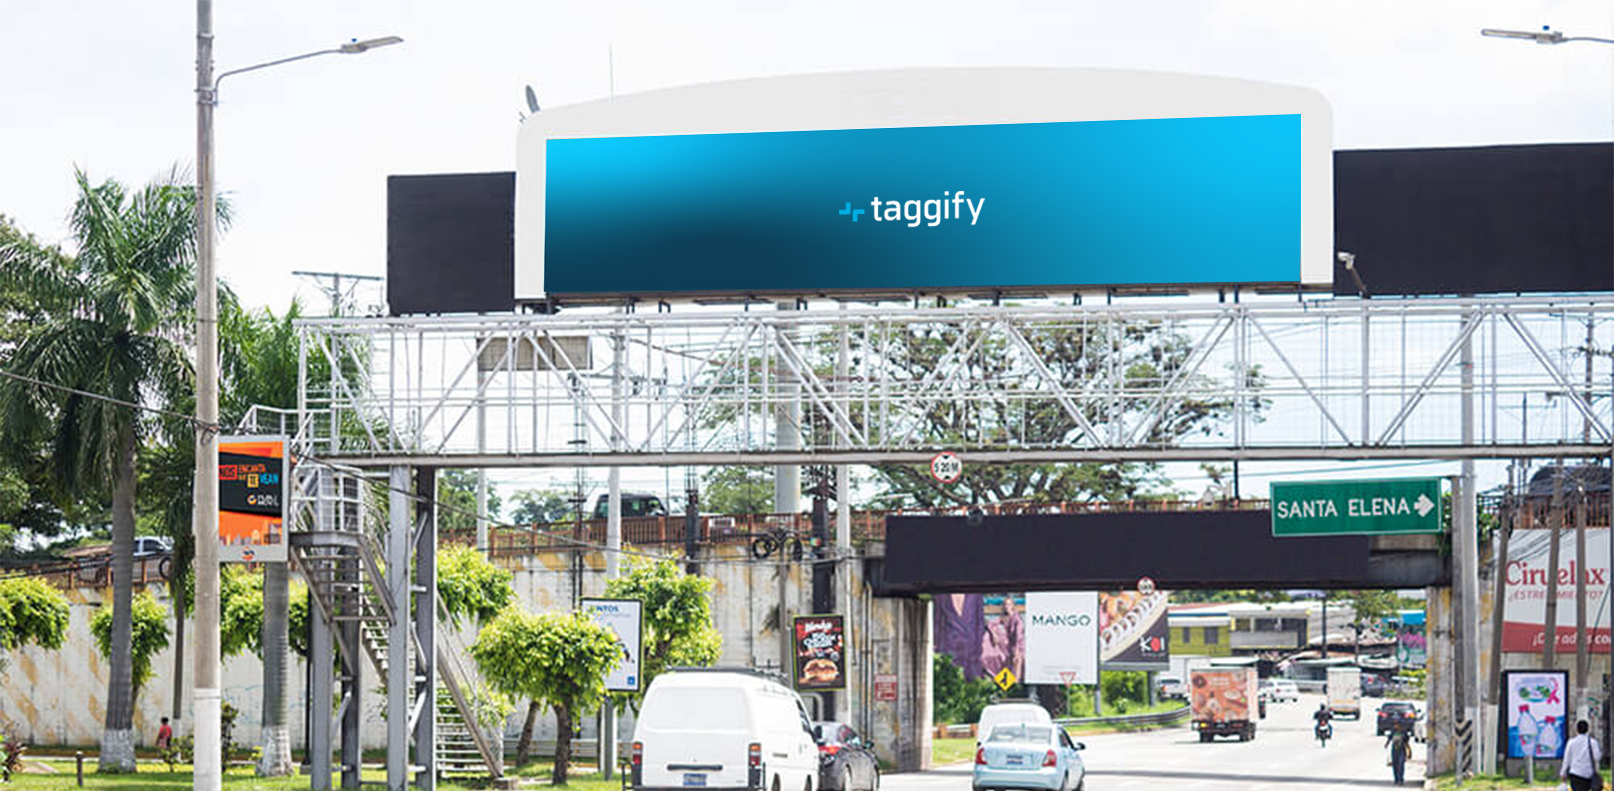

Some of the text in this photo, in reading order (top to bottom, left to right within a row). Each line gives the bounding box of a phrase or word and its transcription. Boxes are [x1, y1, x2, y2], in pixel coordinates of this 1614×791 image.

[870, 190, 985, 228] taggify
[1277, 497, 1411, 519] SANTA ELENA
[1032, 614, 1091, 627] MANGO
[1140, 636, 1165, 652] KOI
